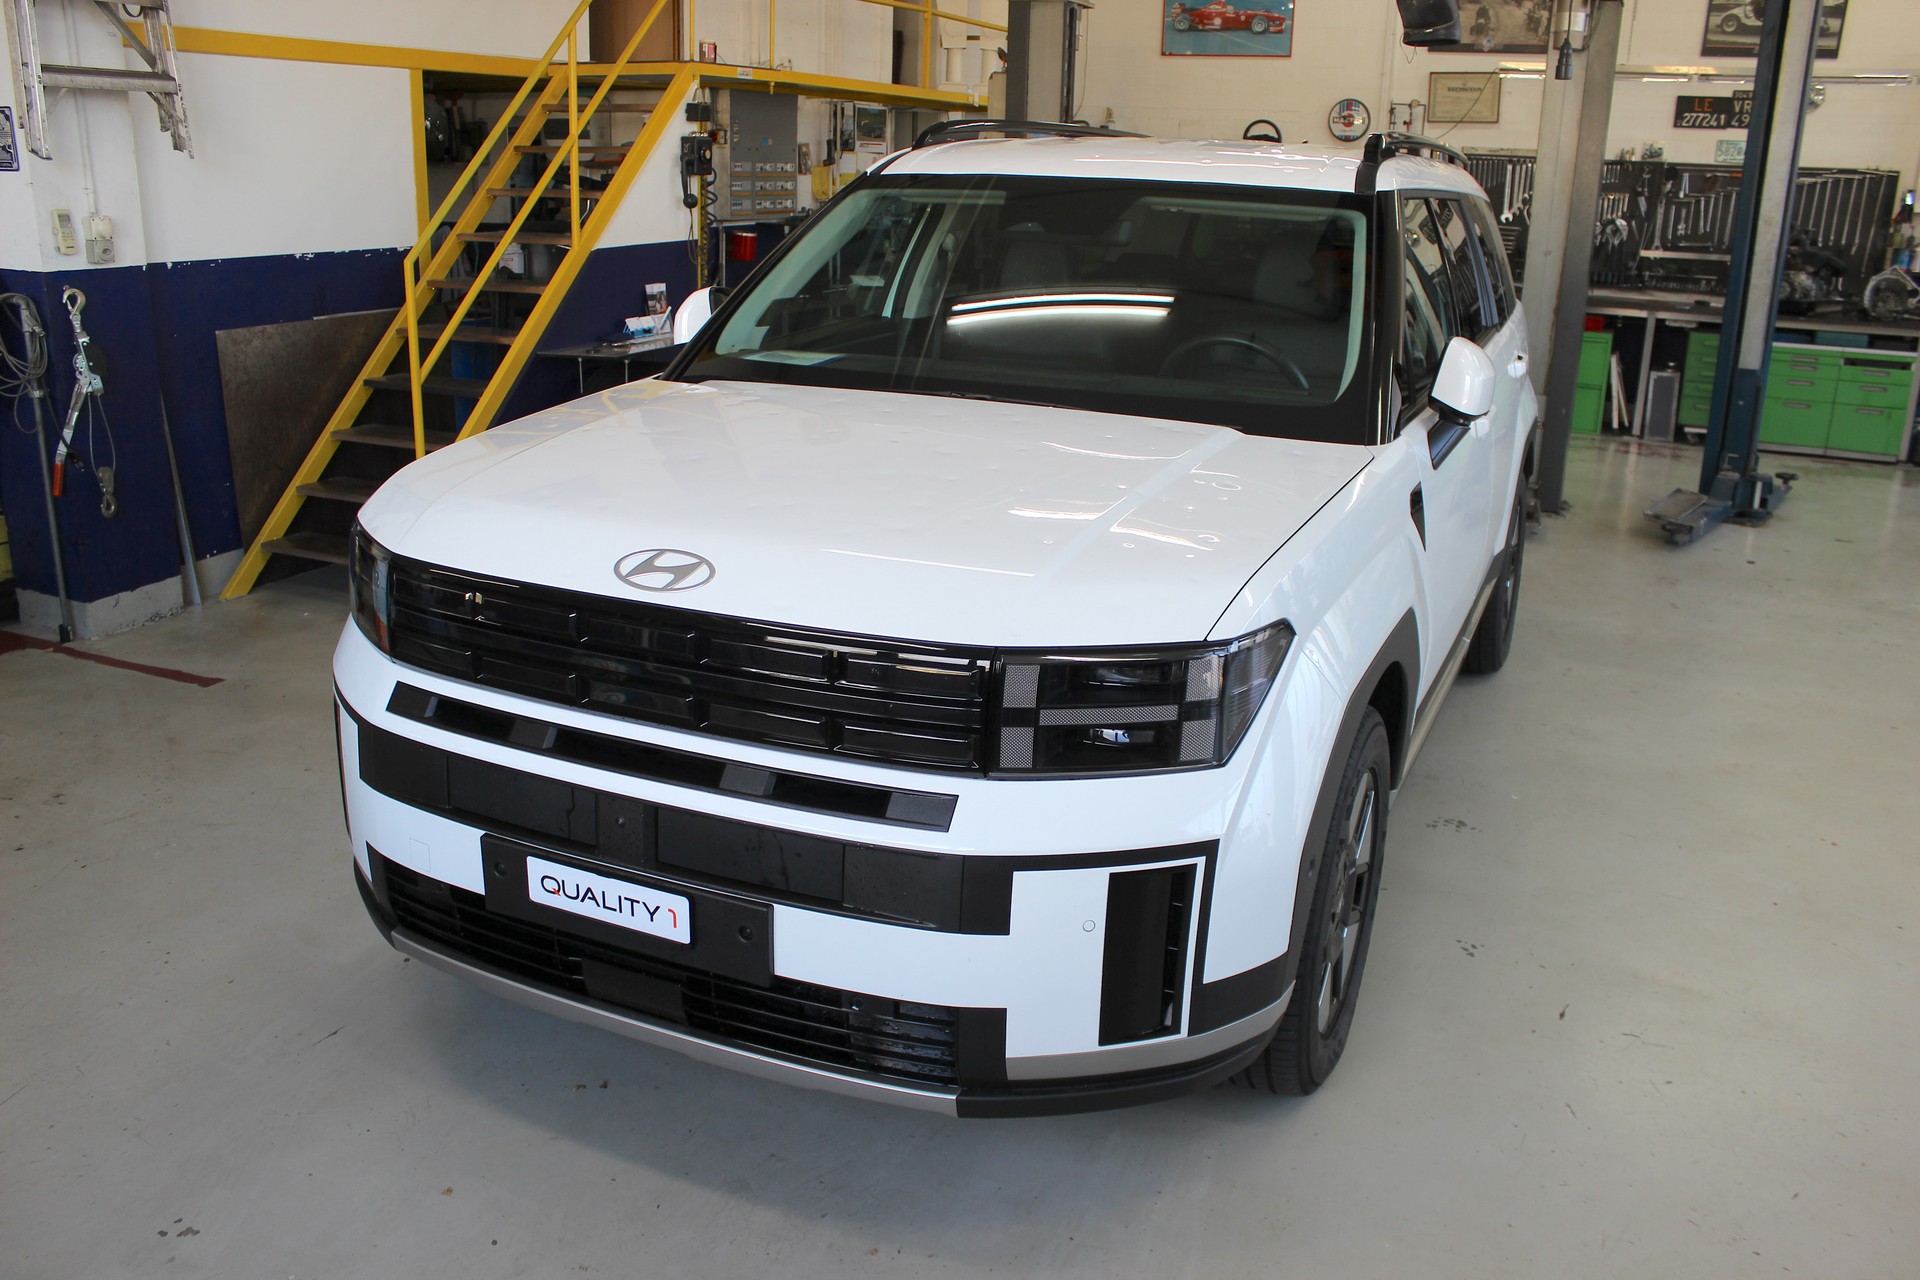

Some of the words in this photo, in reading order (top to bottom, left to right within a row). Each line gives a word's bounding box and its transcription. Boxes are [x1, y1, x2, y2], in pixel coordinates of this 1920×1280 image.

[1694, 98, 1713, 111] LE
[1733, 100, 1753, 113] VR
[1681, 112, 1726, 127] 277241
[540, 874, 661, 923] QUALITY
[667, 908, 678, 929] 1
